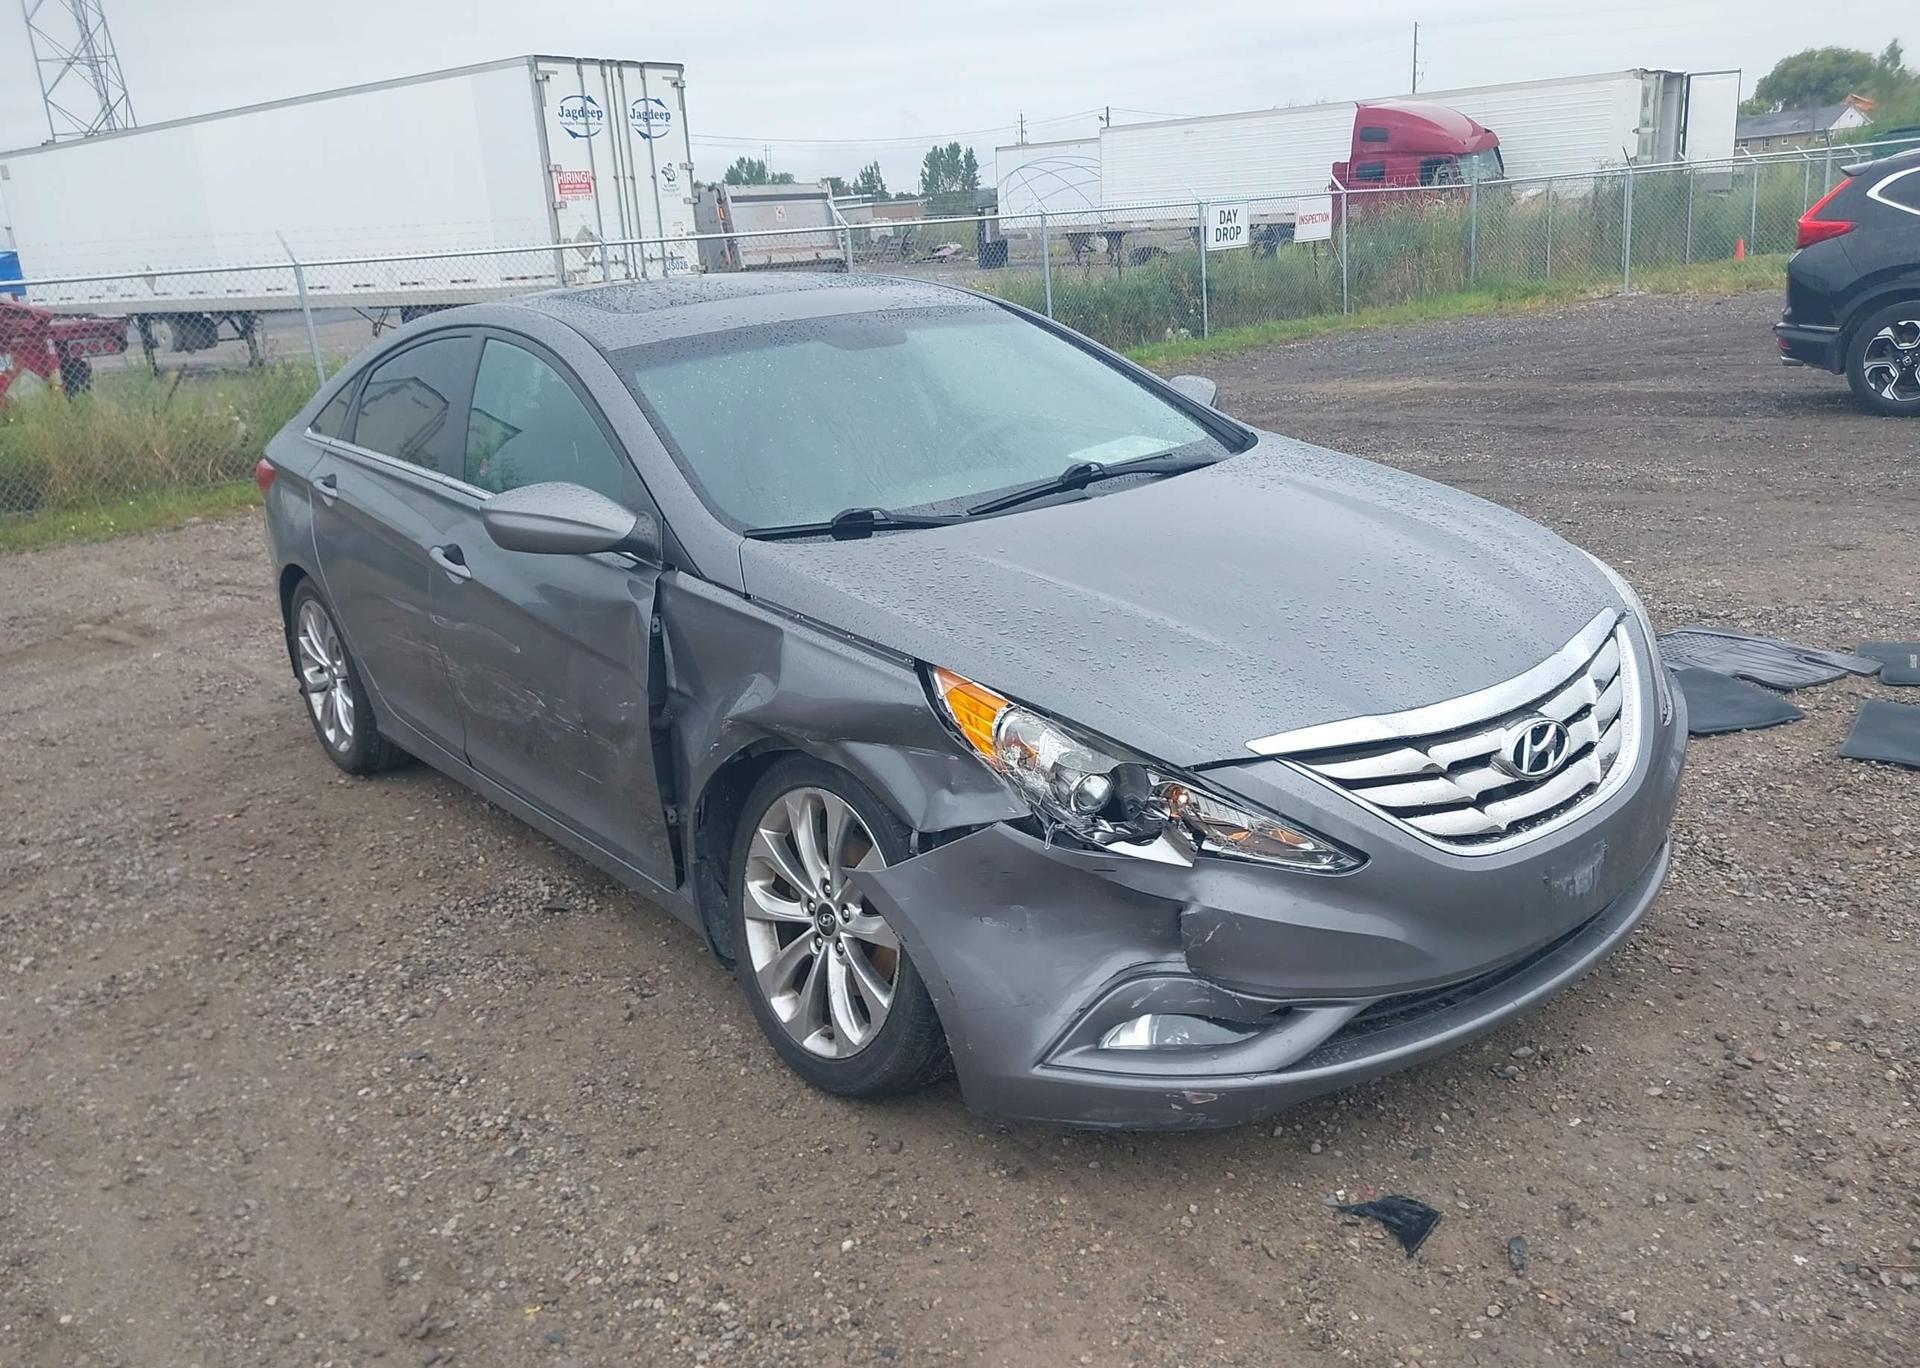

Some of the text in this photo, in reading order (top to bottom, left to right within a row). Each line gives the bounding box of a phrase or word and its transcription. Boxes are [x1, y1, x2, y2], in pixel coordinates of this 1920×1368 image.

[558, 106, 603, 121] Jagdeep
[630, 108, 671, 122] Jagdeep
[557, 172, 590, 184] HIRING!
[1219, 209, 1239, 225] DAY
[1298, 213, 1330, 226] INSPECTION
[1215, 226, 1242, 242] DROP
